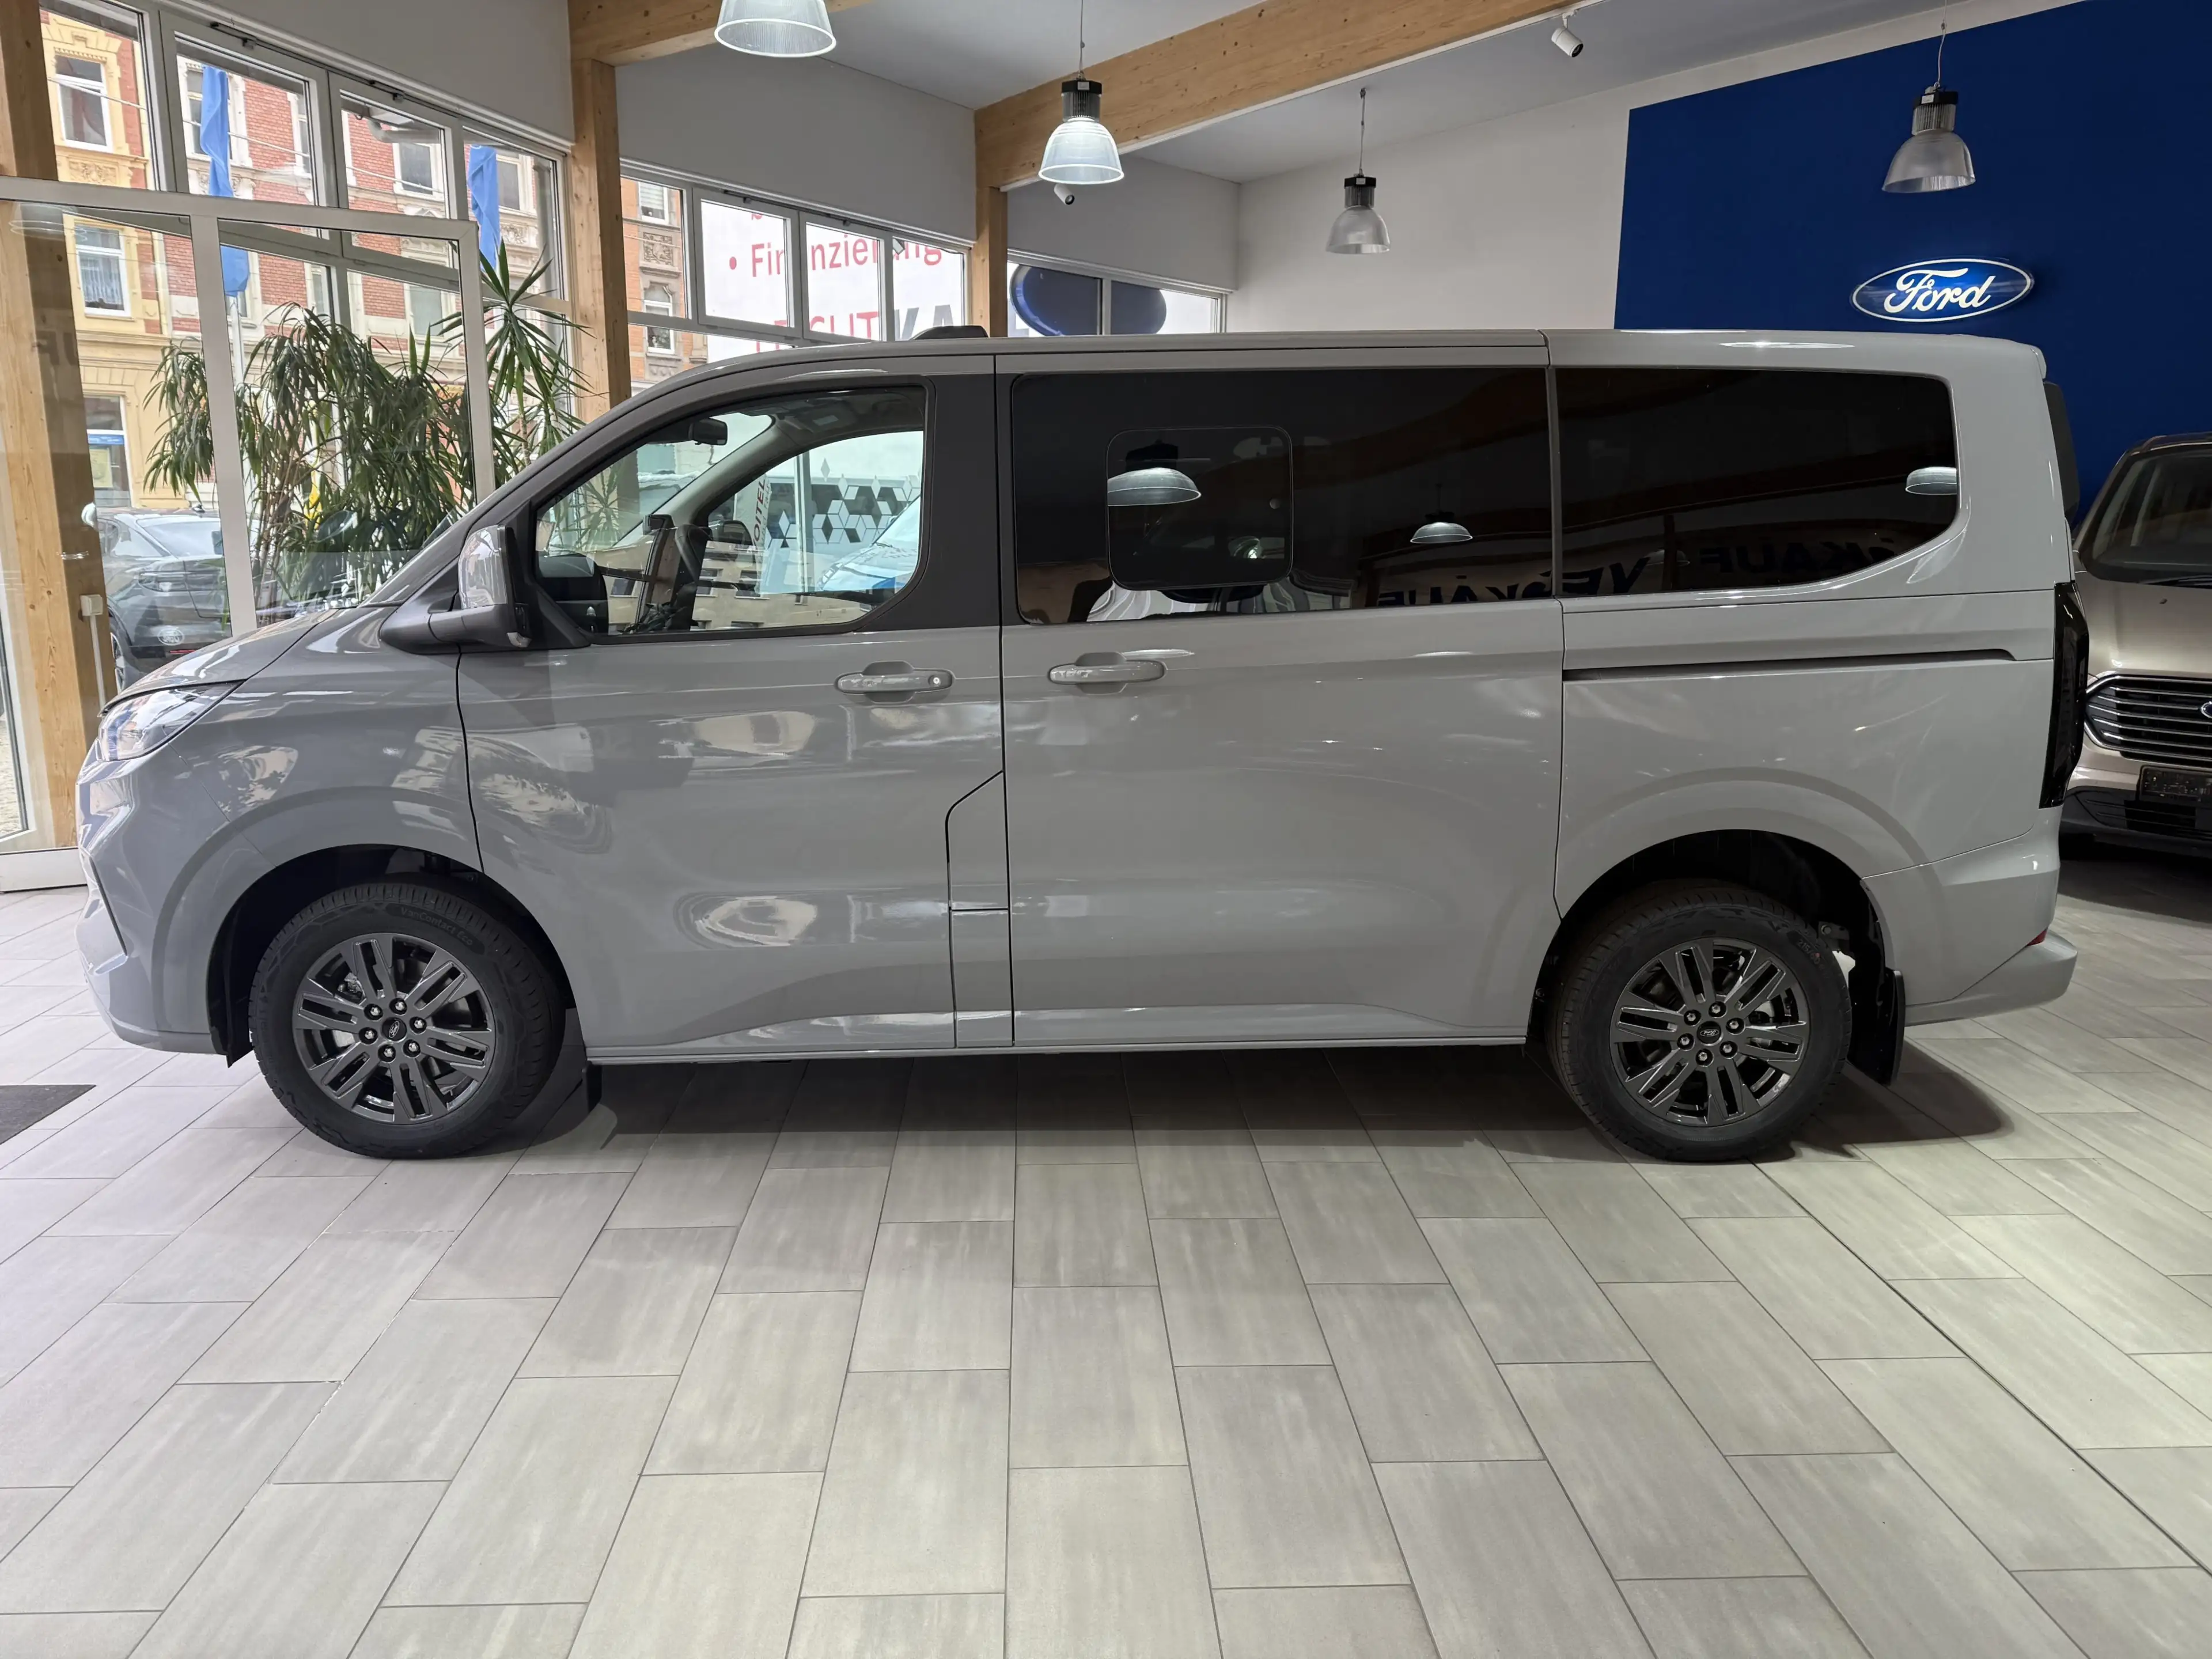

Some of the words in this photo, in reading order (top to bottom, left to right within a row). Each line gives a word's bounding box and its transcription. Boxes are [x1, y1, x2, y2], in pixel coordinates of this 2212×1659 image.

[751, 234, 942, 278] Finnzierng
[1884, 267, 1997, 314] Ford
[400, 907, 457, 934] VanContact
[456, 930, 473, 946] Eco
